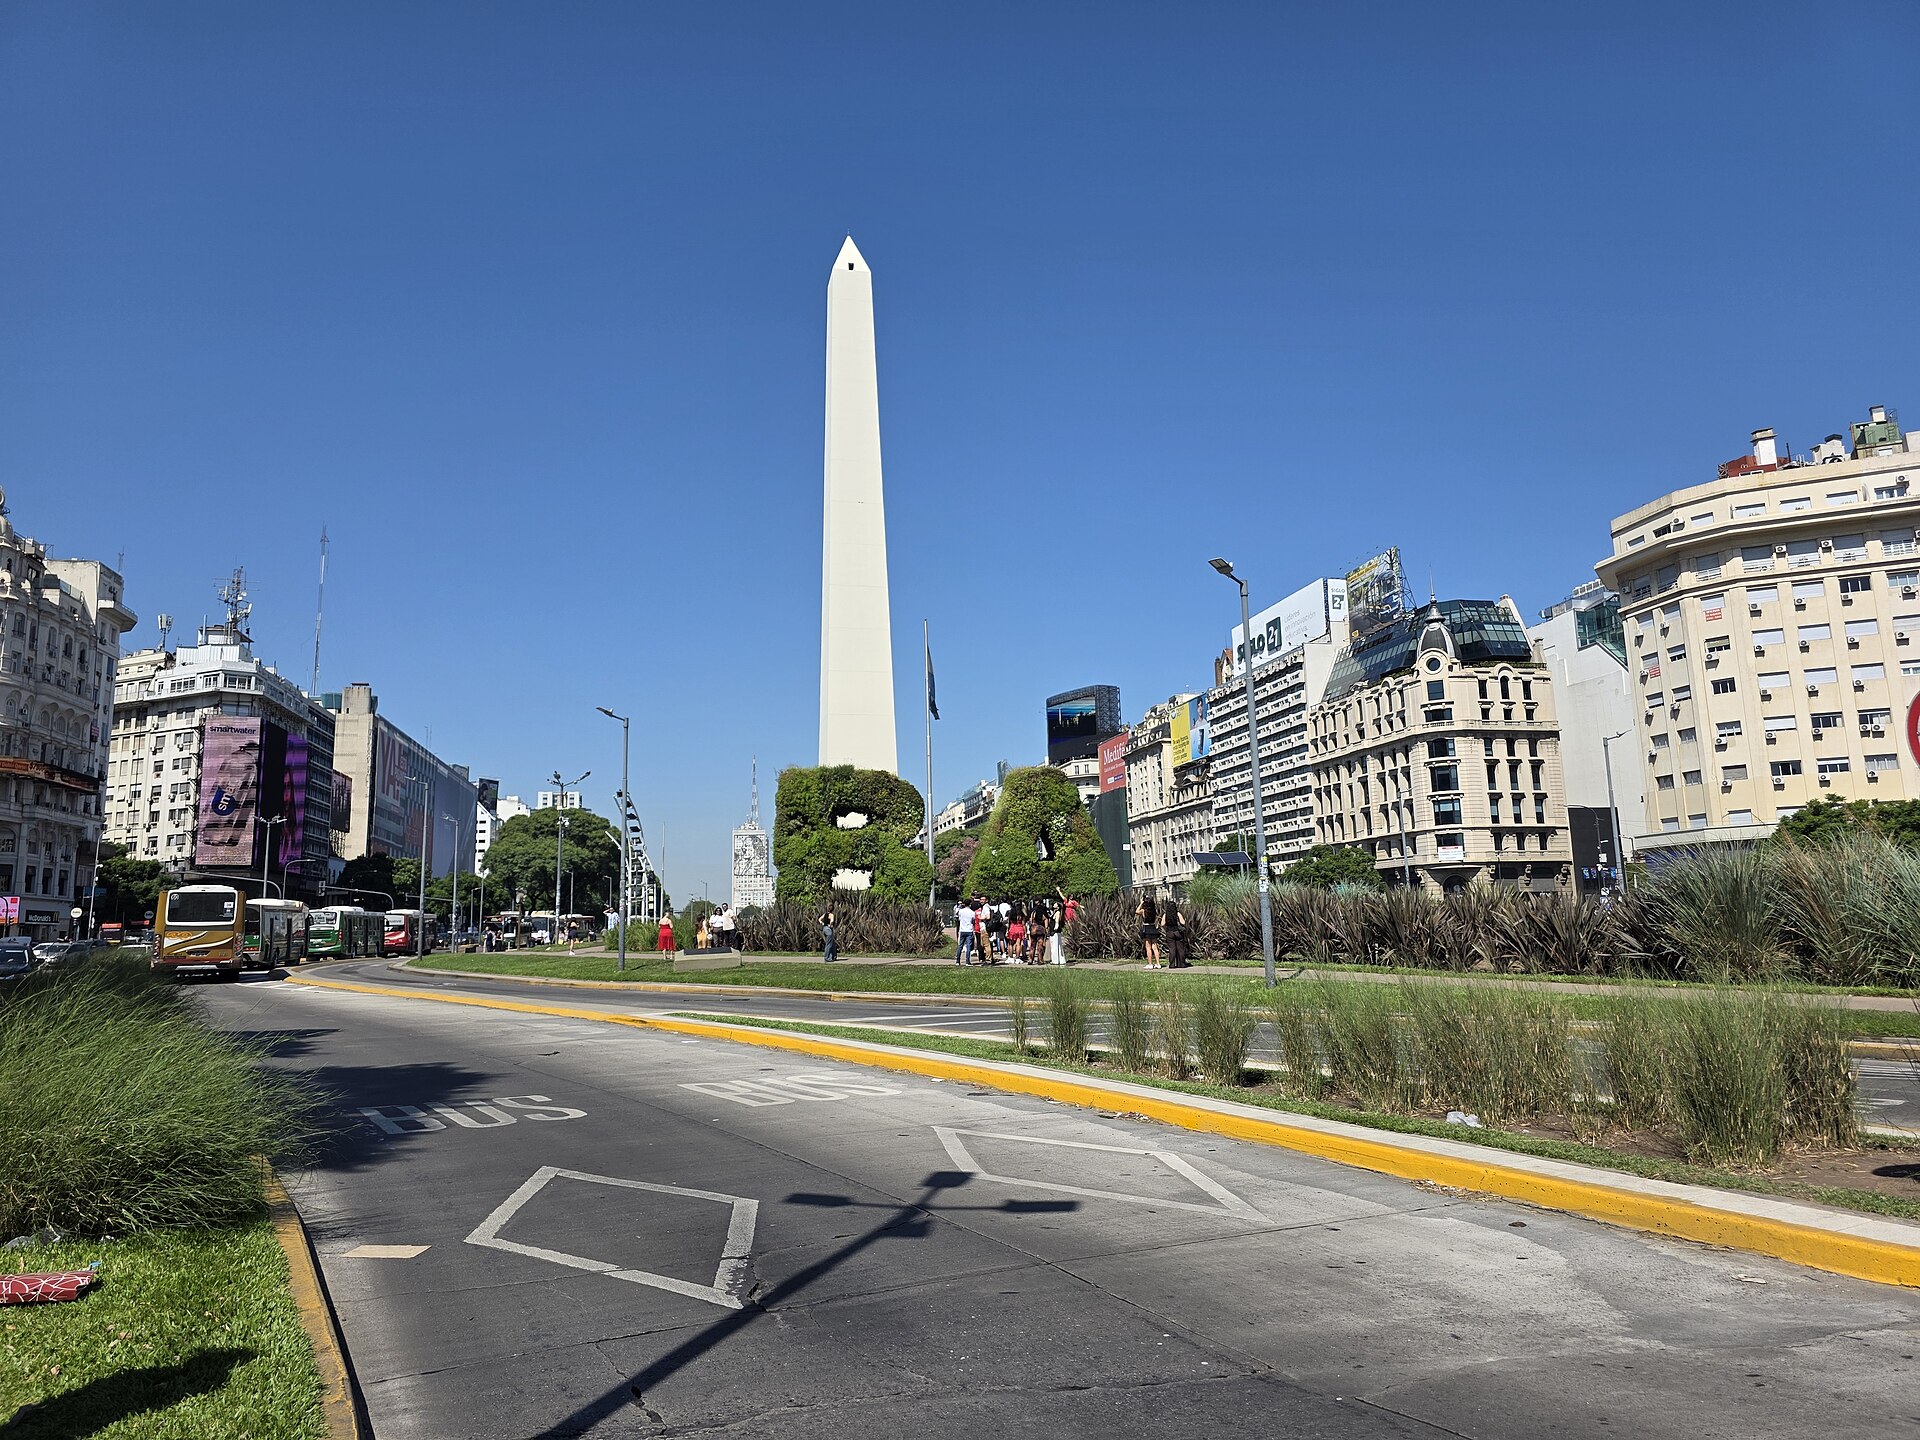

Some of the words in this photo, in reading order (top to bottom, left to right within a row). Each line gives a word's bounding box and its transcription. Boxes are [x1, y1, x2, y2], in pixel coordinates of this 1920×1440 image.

[1237, 634, 1265, 663] SLO
[209, 725, 256, 735] smartwater
[28, 913, 52, 922] McDonald's
[677, 1074, 902, 1107] BUS
[358, 1095, 588, 1135] BUS
